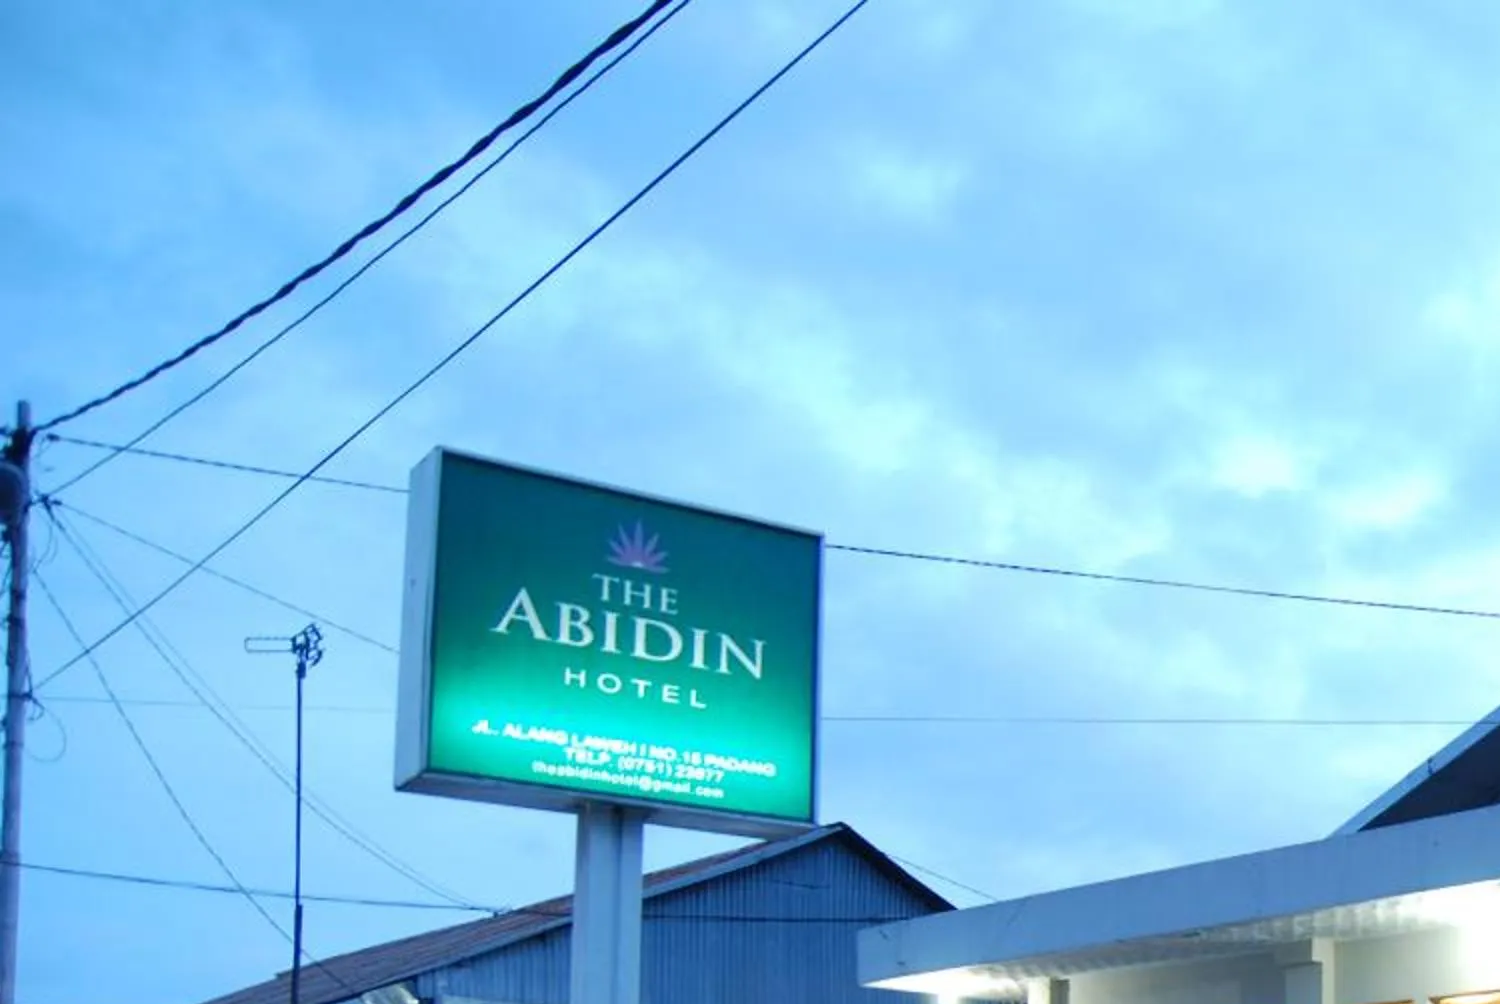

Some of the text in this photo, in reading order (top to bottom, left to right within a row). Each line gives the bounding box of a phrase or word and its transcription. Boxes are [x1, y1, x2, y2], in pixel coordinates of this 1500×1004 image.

[592, 573, 679, 615] THE
[489, 587, 767, 681] ABIDIN
[564, 667, 708, 710] HOTEL
[703, 752, 777, 778] PADANG
